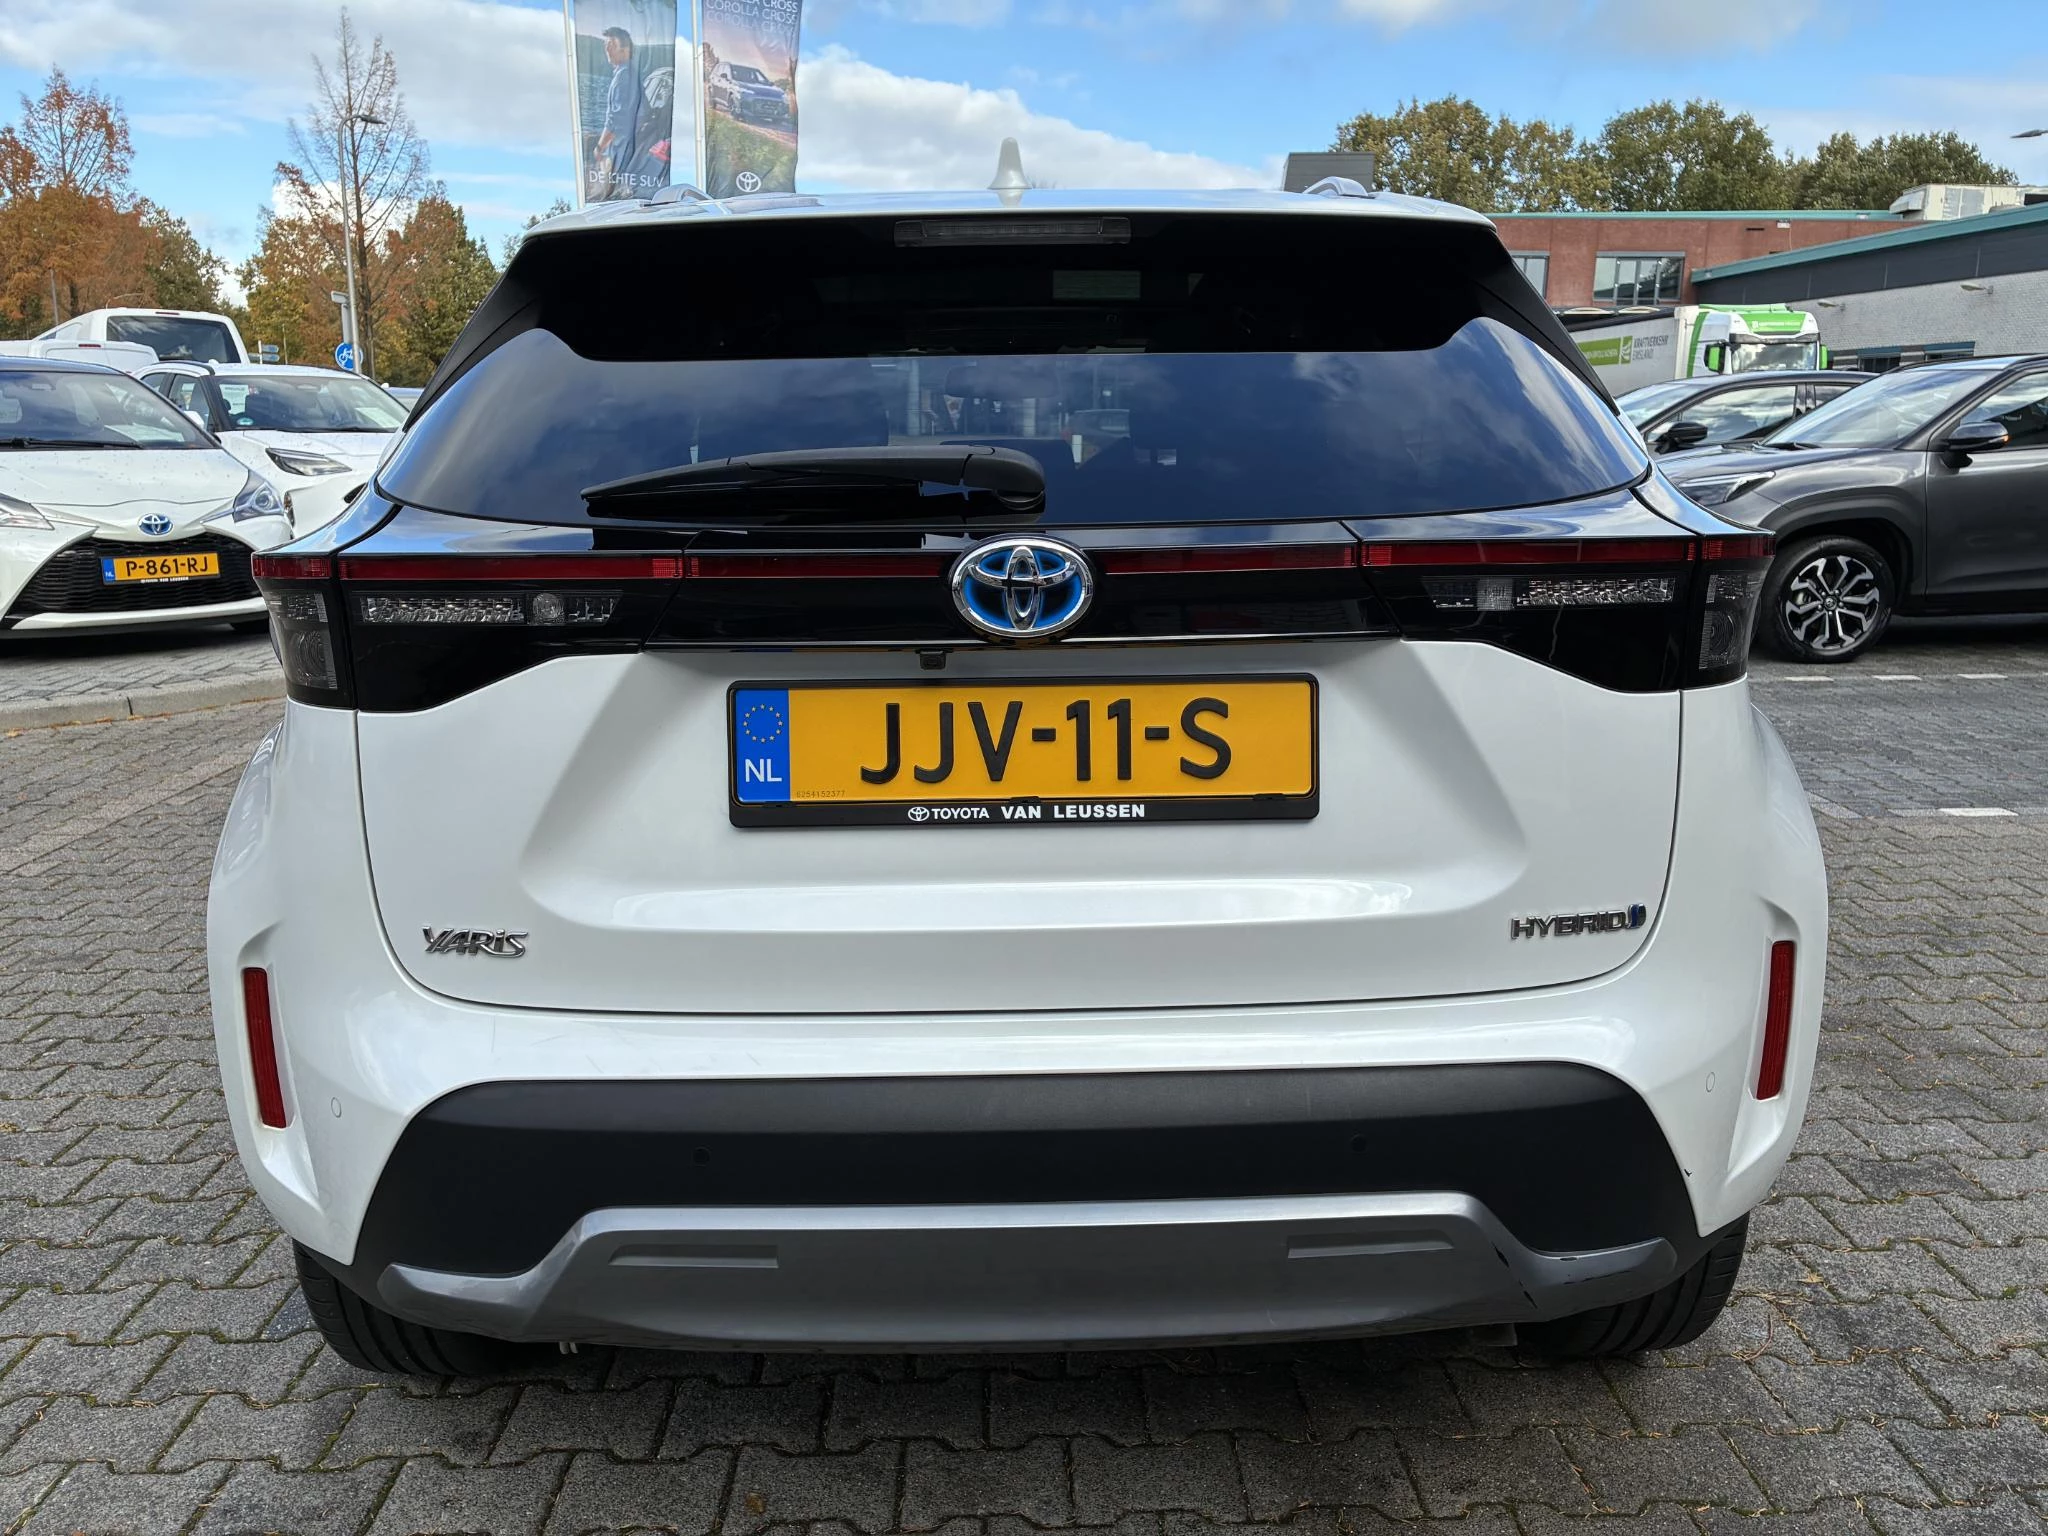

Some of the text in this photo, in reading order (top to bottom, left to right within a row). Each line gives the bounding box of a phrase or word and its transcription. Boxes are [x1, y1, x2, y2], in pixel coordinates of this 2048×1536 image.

[706, 0, 799, 25] COROLLA CROSS
[589, 170, 605, 184] DE
[640, 174, 664, 188] SUV
[126, 556, 208, 577] P-861-RJ
[859, 696, 1232, 785] JJV-11-S
[744, 758, 783, 783] NL
[931, 804, 1145, 820] TOYOTA VAN LEUSSEN
[1511, 910, 1627, 939] HYBRID
